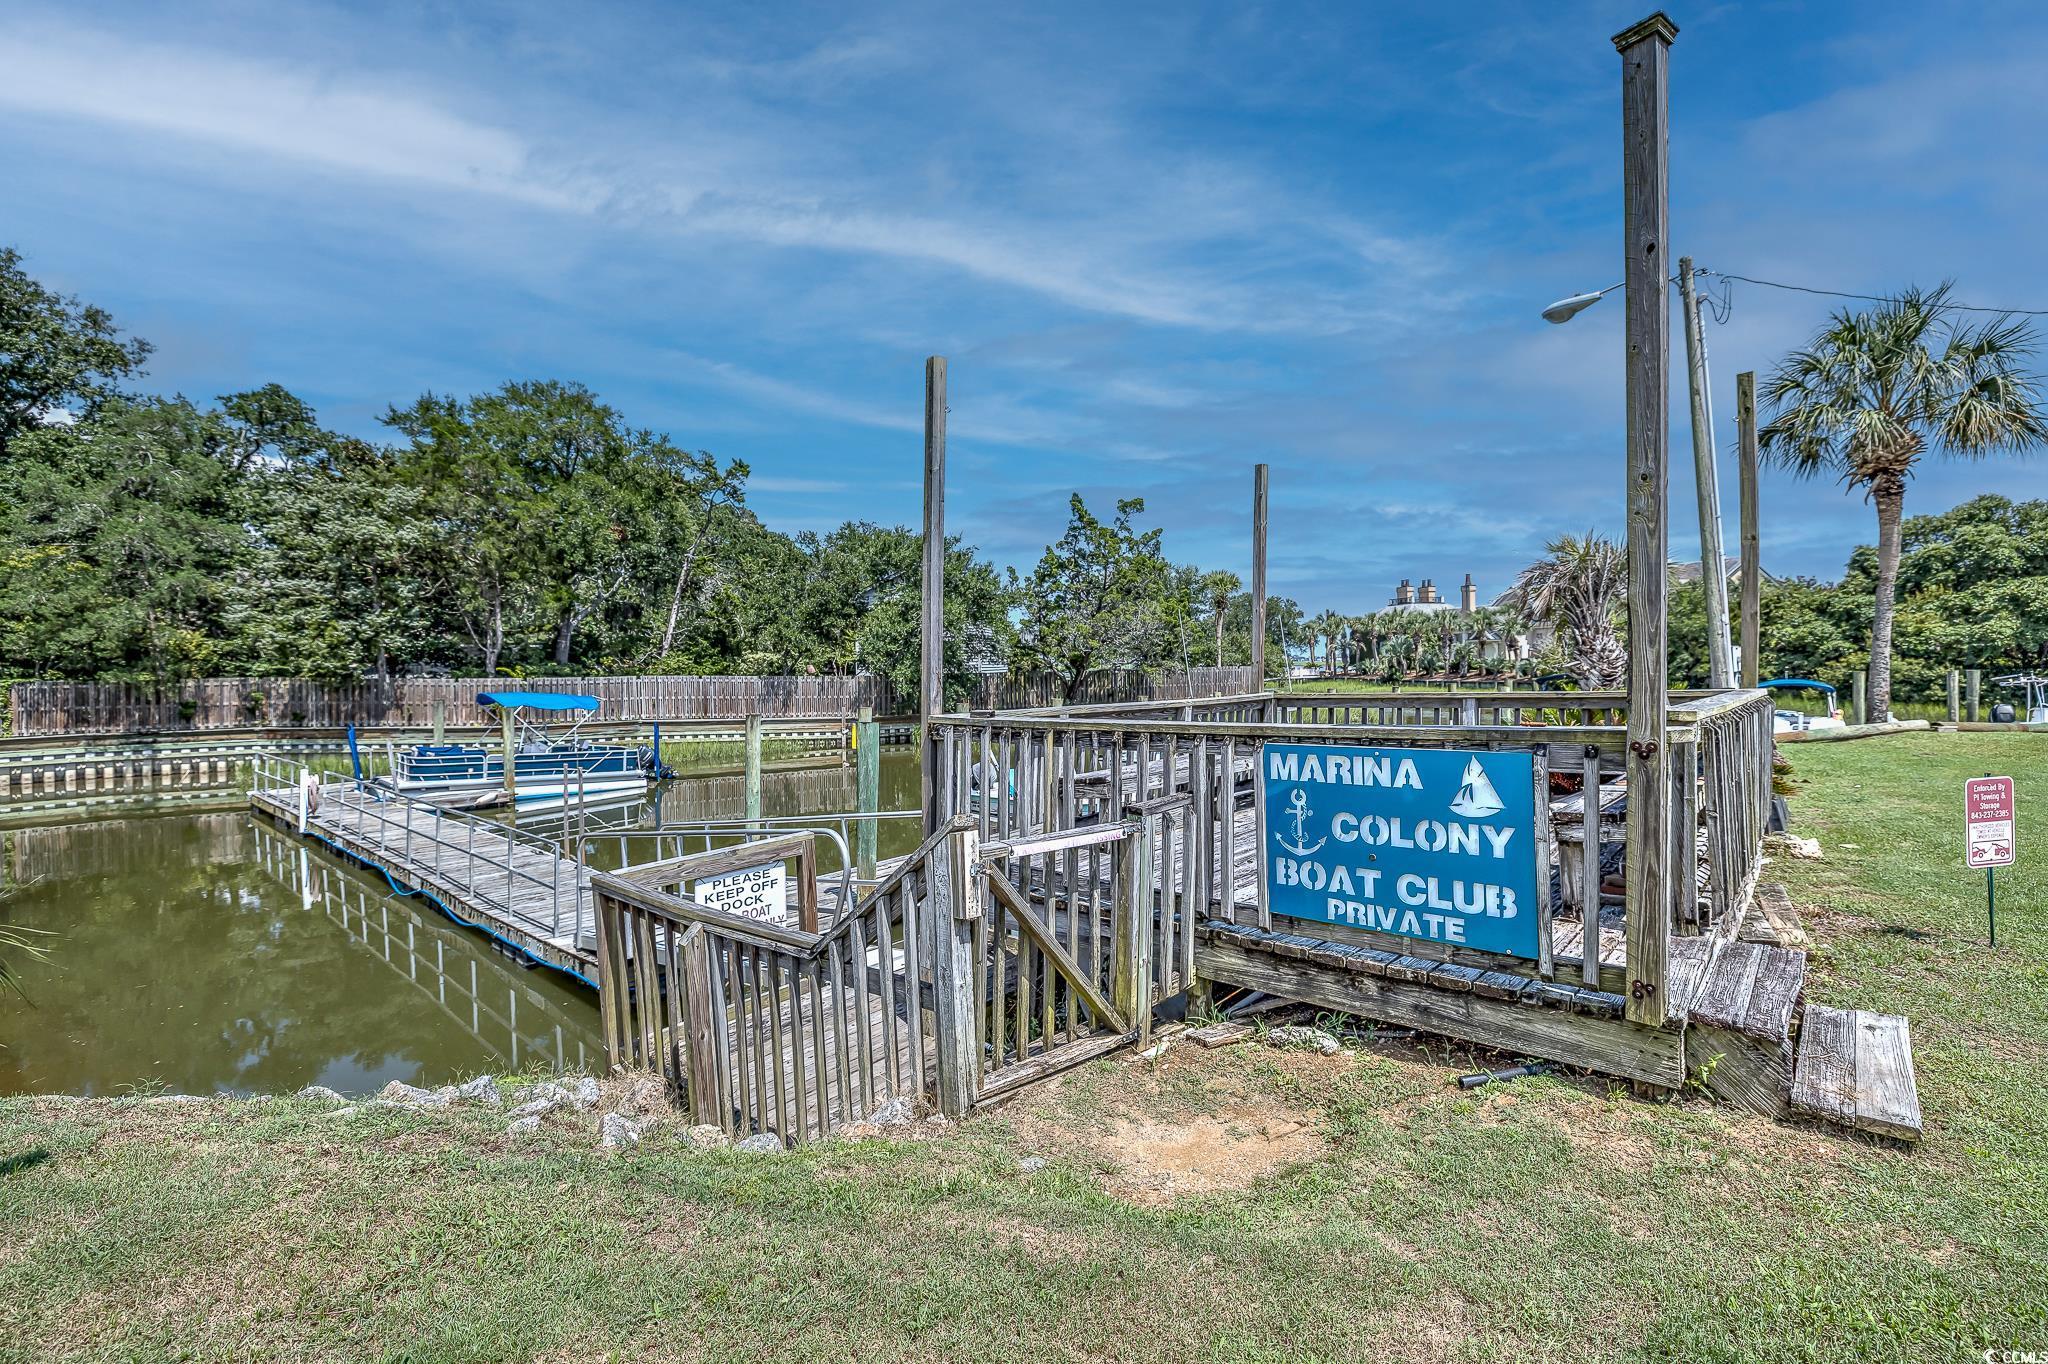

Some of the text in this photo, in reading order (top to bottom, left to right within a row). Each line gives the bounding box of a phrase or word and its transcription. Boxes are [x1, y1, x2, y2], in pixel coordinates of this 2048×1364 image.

[1269, 752, 1424, 790] MARINA
[1979, 802, 2000, 810] Storage
[1980, 793, 2000, 801] Towing
[1331, 811, 1516, 859] COLONY
[712, 868, 771, 890] PLEASE
[1275, 857, 1518, 919] BOAT CLUB
[704, 878, 779, 905] KEEP OFF
[721, 894, 764, 912] DOCK
[742, 903, 772, 919] BOAT
[1327, 898, 1467, 943] PRIVATE
